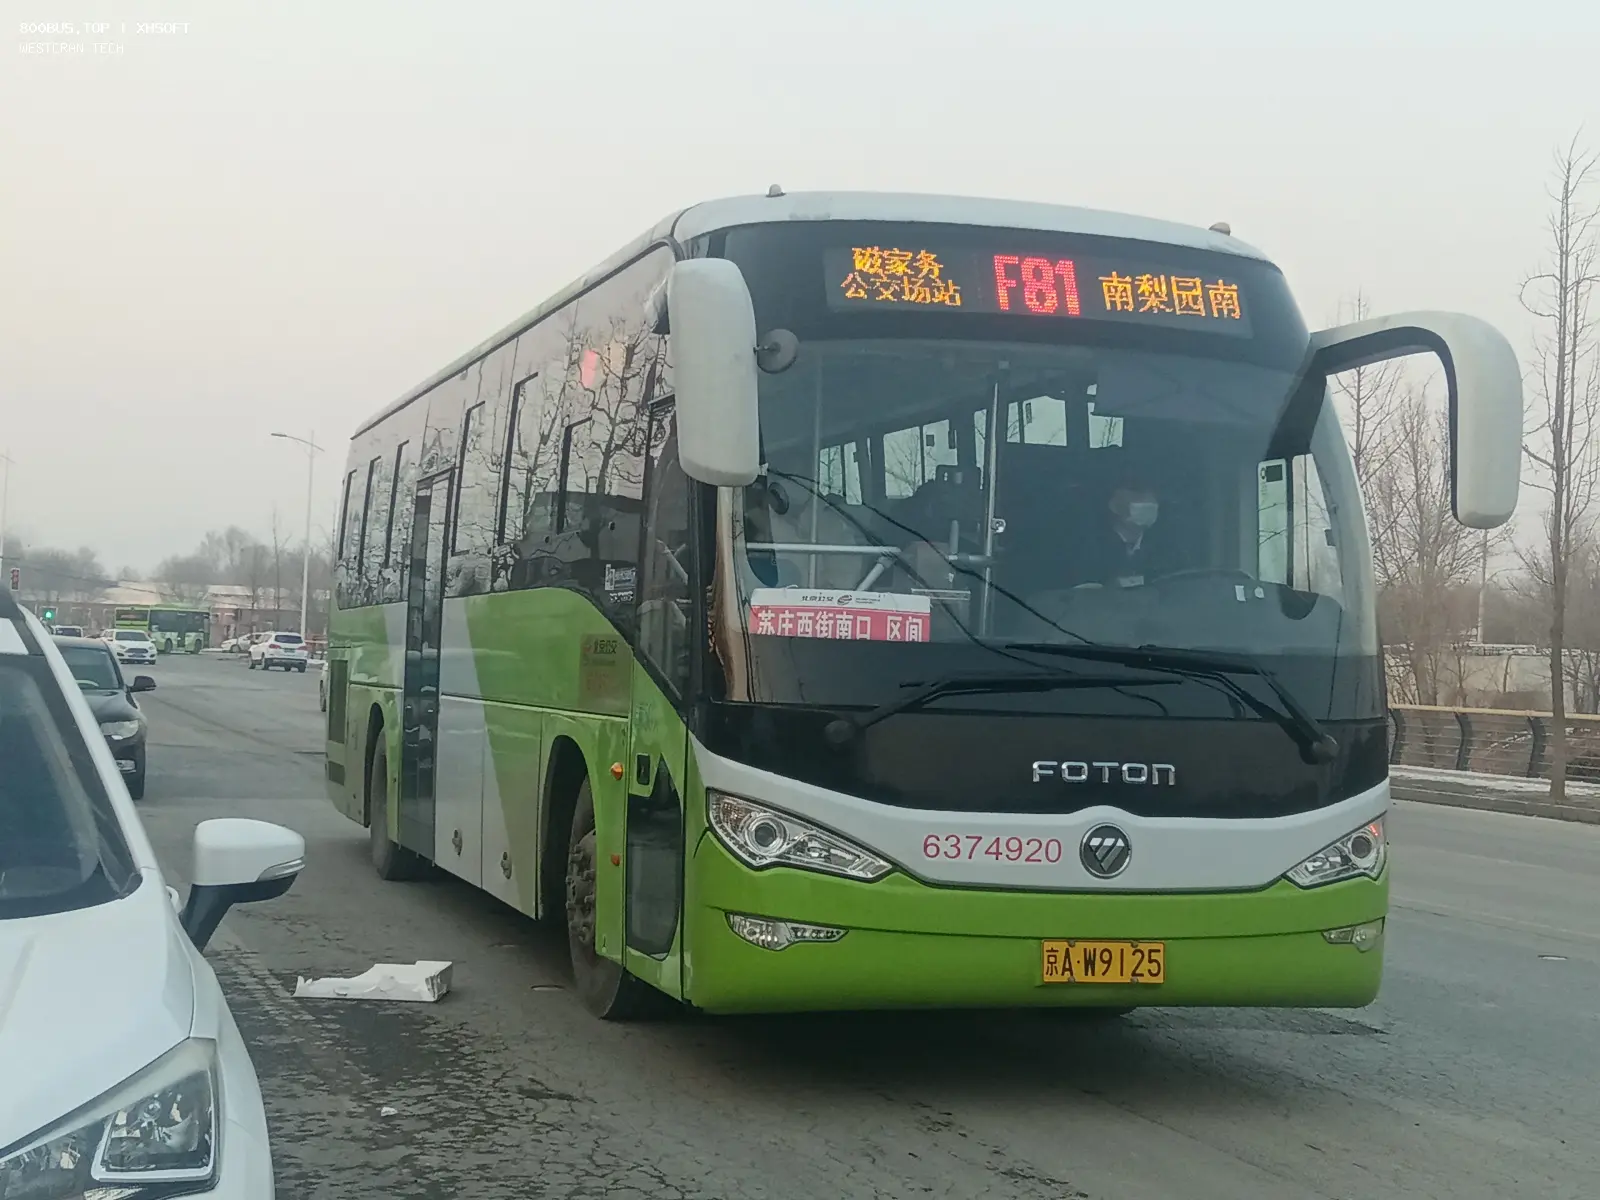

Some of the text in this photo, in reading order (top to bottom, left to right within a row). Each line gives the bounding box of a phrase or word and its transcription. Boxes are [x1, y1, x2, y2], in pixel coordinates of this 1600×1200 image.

[841, 271, 962, 306] 公交场站
[993, 254, 1081, 316] F81
[1098, 271, 1241, 319] 南梨园南
[757, 610, 923, 642] 苏庄西街南口 区间
[1032, 760, 1176, 785] FOTON
[923, 834, 1063, 863] 6374920
